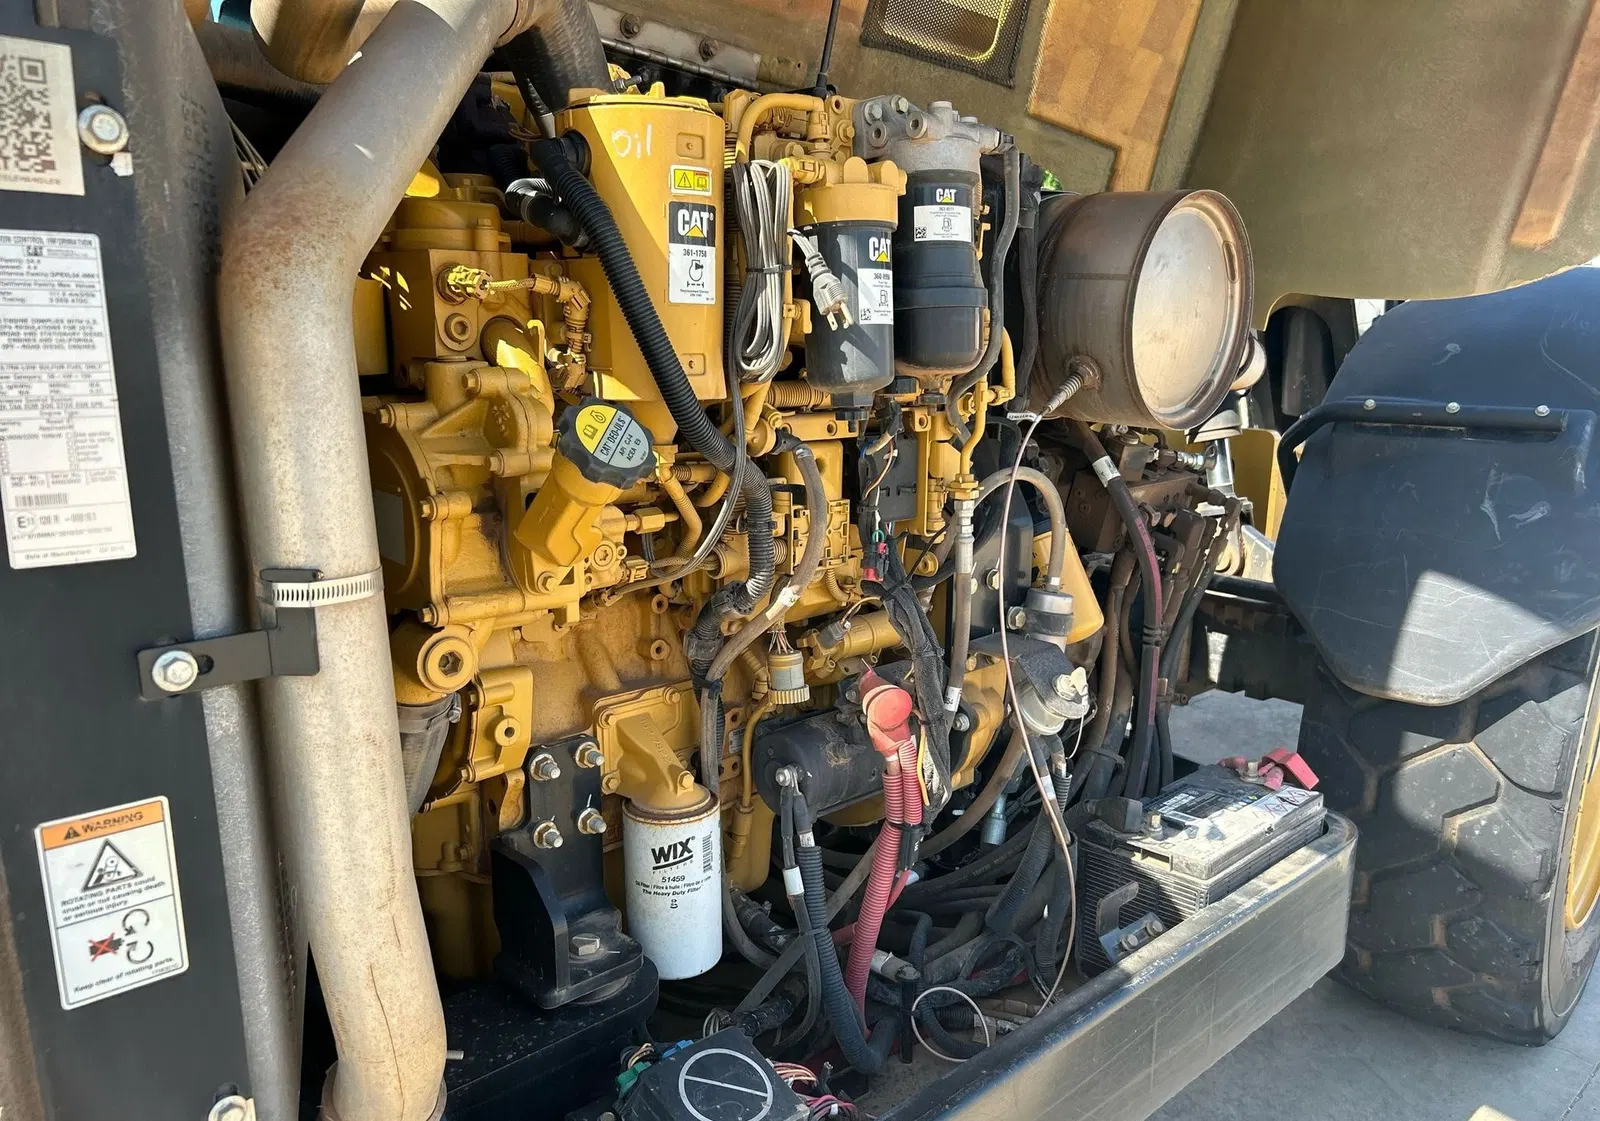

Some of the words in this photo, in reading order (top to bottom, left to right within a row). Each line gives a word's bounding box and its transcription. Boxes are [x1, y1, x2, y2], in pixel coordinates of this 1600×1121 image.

[612, 124, 653, 159] Oil
[936, 188, 957, 203] CAT
[677, 209, 710, 237] CAT
[868, 237, 891, 262] CAT
[600, 443, 612, 456] CAT
[606, 417, 626, 444] DEO-ULS
[626, 448, 637, 461] ACEA
[81, 811, 144, 834] WARNING
[651, 837, 693, 864] WIX
[661, 875, 686, 883] 51459
[61, 890, 104, 907] ROTATING
[105, 883, 132, 894] PARTS
[74, 983, 93, 993] Keep
[95, 977, 114, 986] clear
[115, 972, 123, 980] of
